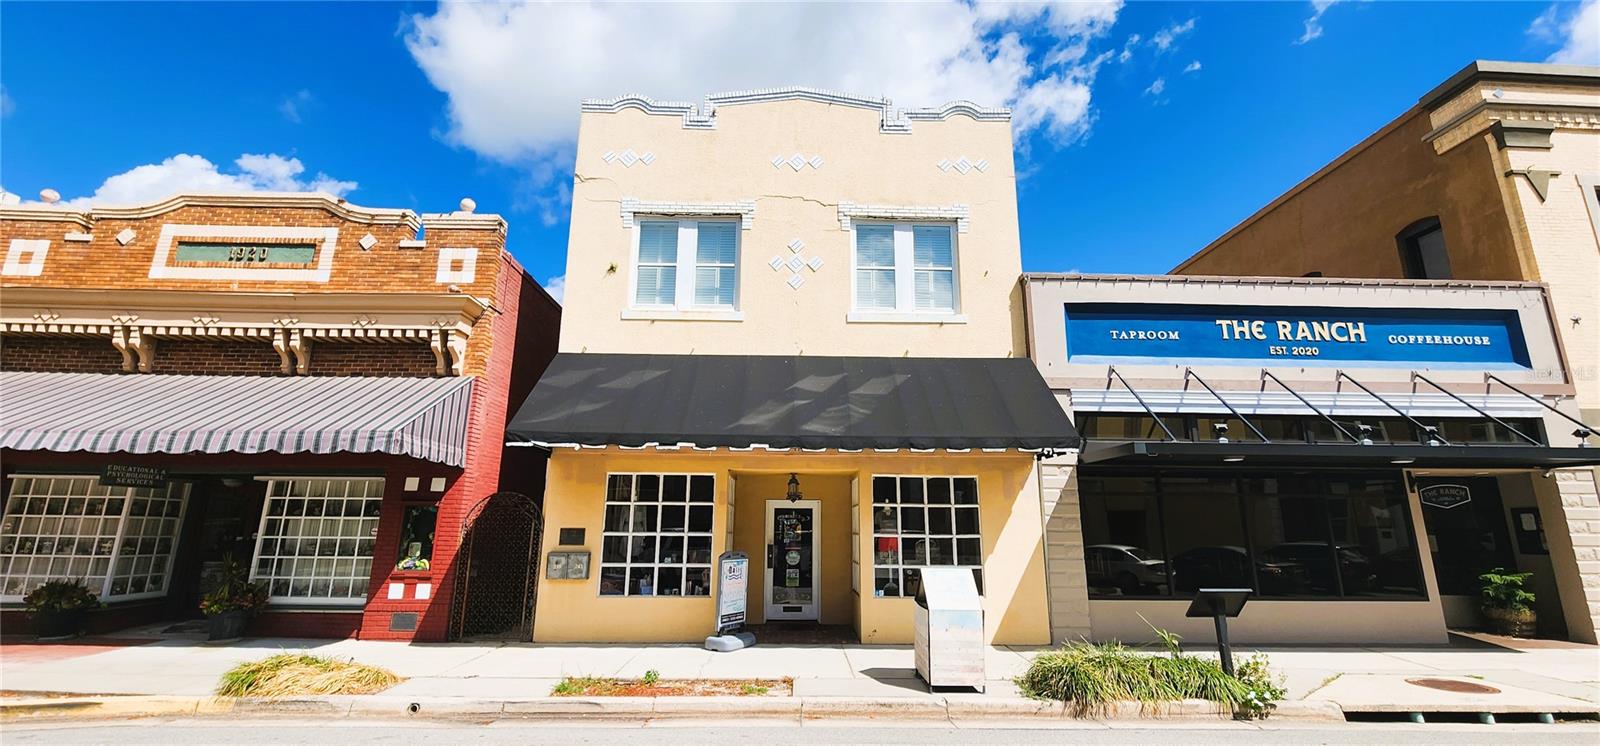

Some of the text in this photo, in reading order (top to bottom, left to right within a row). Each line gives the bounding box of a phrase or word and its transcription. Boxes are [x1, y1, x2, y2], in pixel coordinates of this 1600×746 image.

[229, 247, 268, 261] 1920
[1110, 330, 1180, 340] TAPROOM
[1216, 319, 1367, 343] THE RANCH
[1388, 334, 1491, 345] COFFEEHOUSE
[1269, 345, 1320, 356] EST. 2020
[107, 464, 159, 474] EDUCATIONAL
[1440, 488, 1466, 497] RANCH
